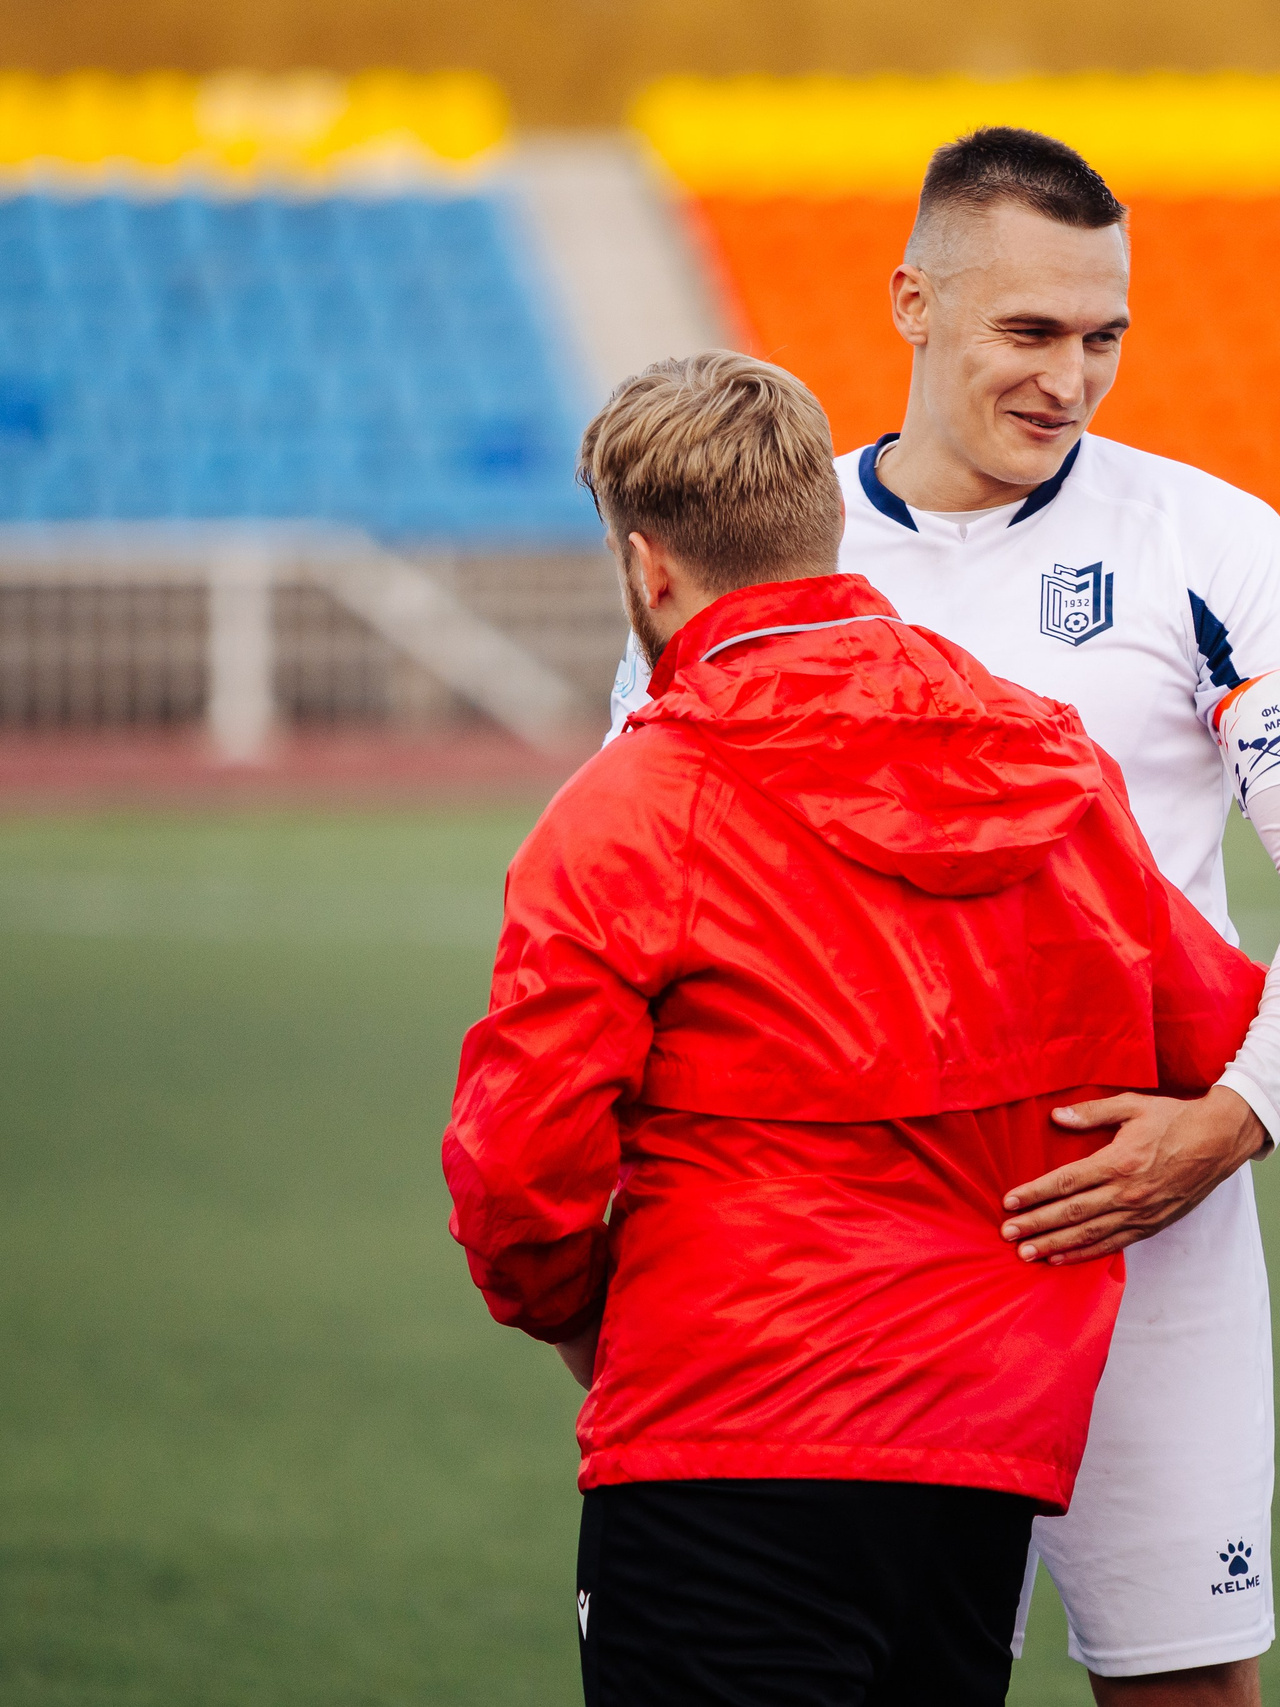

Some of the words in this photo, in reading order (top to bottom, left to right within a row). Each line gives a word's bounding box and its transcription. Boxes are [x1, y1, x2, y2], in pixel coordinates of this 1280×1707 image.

[1064, 598, 1090, 608] 1932
[1261, 704, 1280, 718] ФК
[1211, 1574, 1260, 1596] KELME
